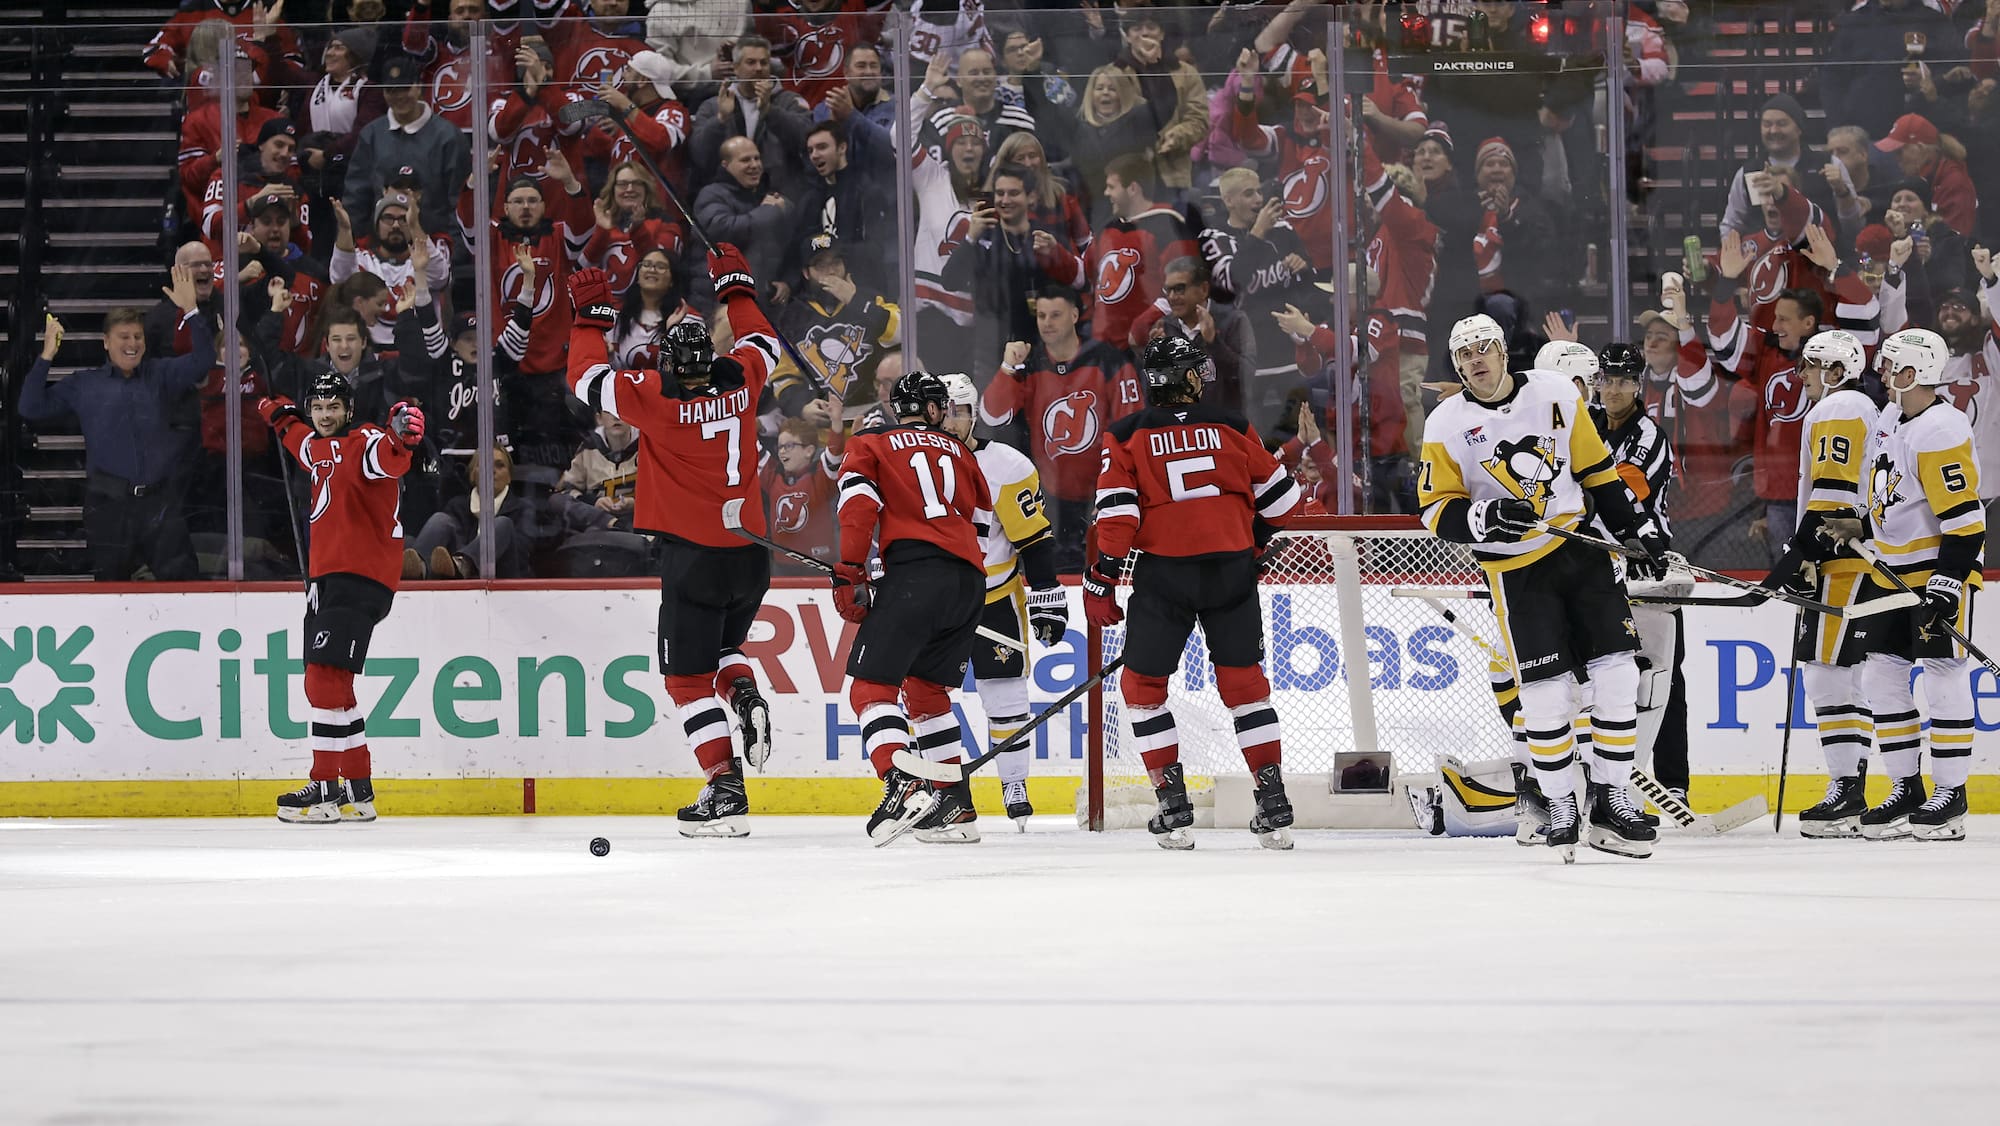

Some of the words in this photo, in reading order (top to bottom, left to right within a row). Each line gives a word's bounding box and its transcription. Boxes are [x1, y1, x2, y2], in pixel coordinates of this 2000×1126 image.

[911, 31, 940, 55] 30
[1433, 61, 1515, 71] DAKTRONICS
[656, 109, 684, 129] 43
[452, 359, 464, 377] C
[1119, 379, 1140, 404] 13
[1552, 402, 1566, 430] A
[331, 440, 343, 463] C
[701, 415, 741, 487] 7
[889, 433, 962, 458] NOESEN
[1150, 428, 1222, 457] DILLON
[1466, 434, 1488, 447] FNB
[1634, 445, 1650, 461] 15
[1816, 435, 1851, 466] 19
[911, 451, 960, 520] 11
[1165, 456, 1222, 502] 5
[1939, 462, 1968, 494] 5
[1519, 652, 1559, 670] BAUER
[125, 628, 656, 740] Citzens
